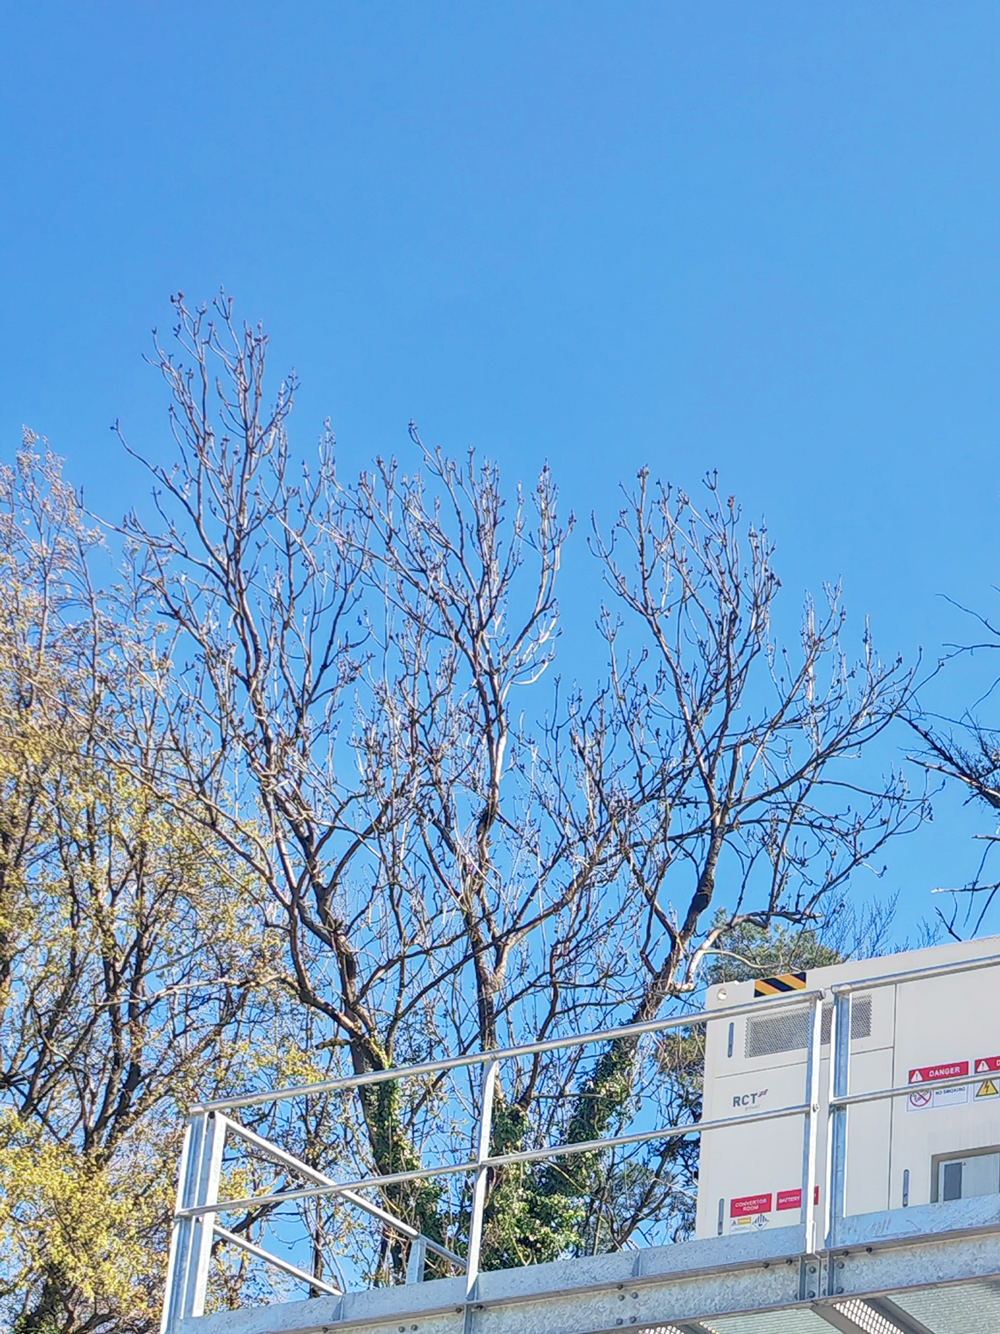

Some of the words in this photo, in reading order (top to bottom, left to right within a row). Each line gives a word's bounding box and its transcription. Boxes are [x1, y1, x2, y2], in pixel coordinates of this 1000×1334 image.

[928, 1066, 961, 1077] DANGER
[733, 1092, 758, 1108] RCT
[734, 1198, 767, 1208] CONVERTOR
[778, 1196, 800, 1204] BATTERY
